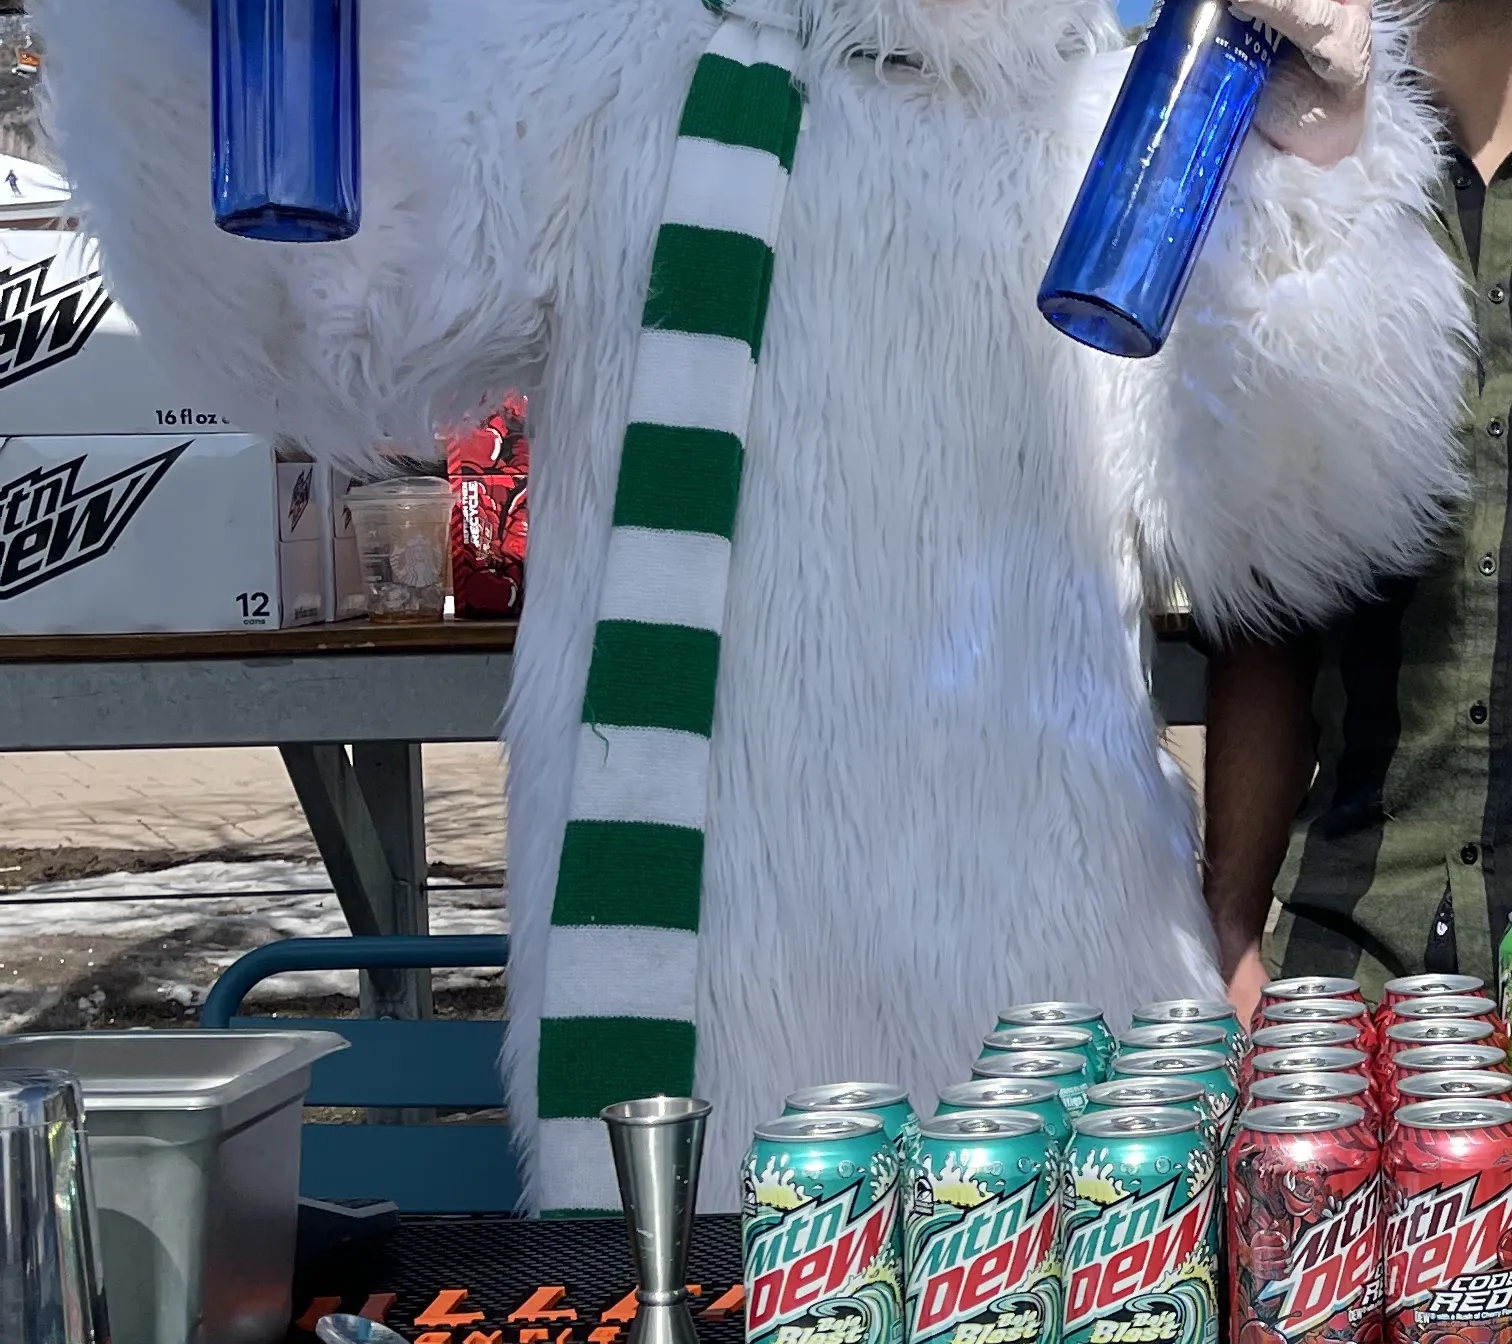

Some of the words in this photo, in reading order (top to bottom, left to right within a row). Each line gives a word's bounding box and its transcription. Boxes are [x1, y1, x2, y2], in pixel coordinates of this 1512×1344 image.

[156, 410, 177, 425] 16
[195, 413, 218, 425] oz
[468, 481, 480, 548] RECYCLE
[235, 591, 270, 617] 12
